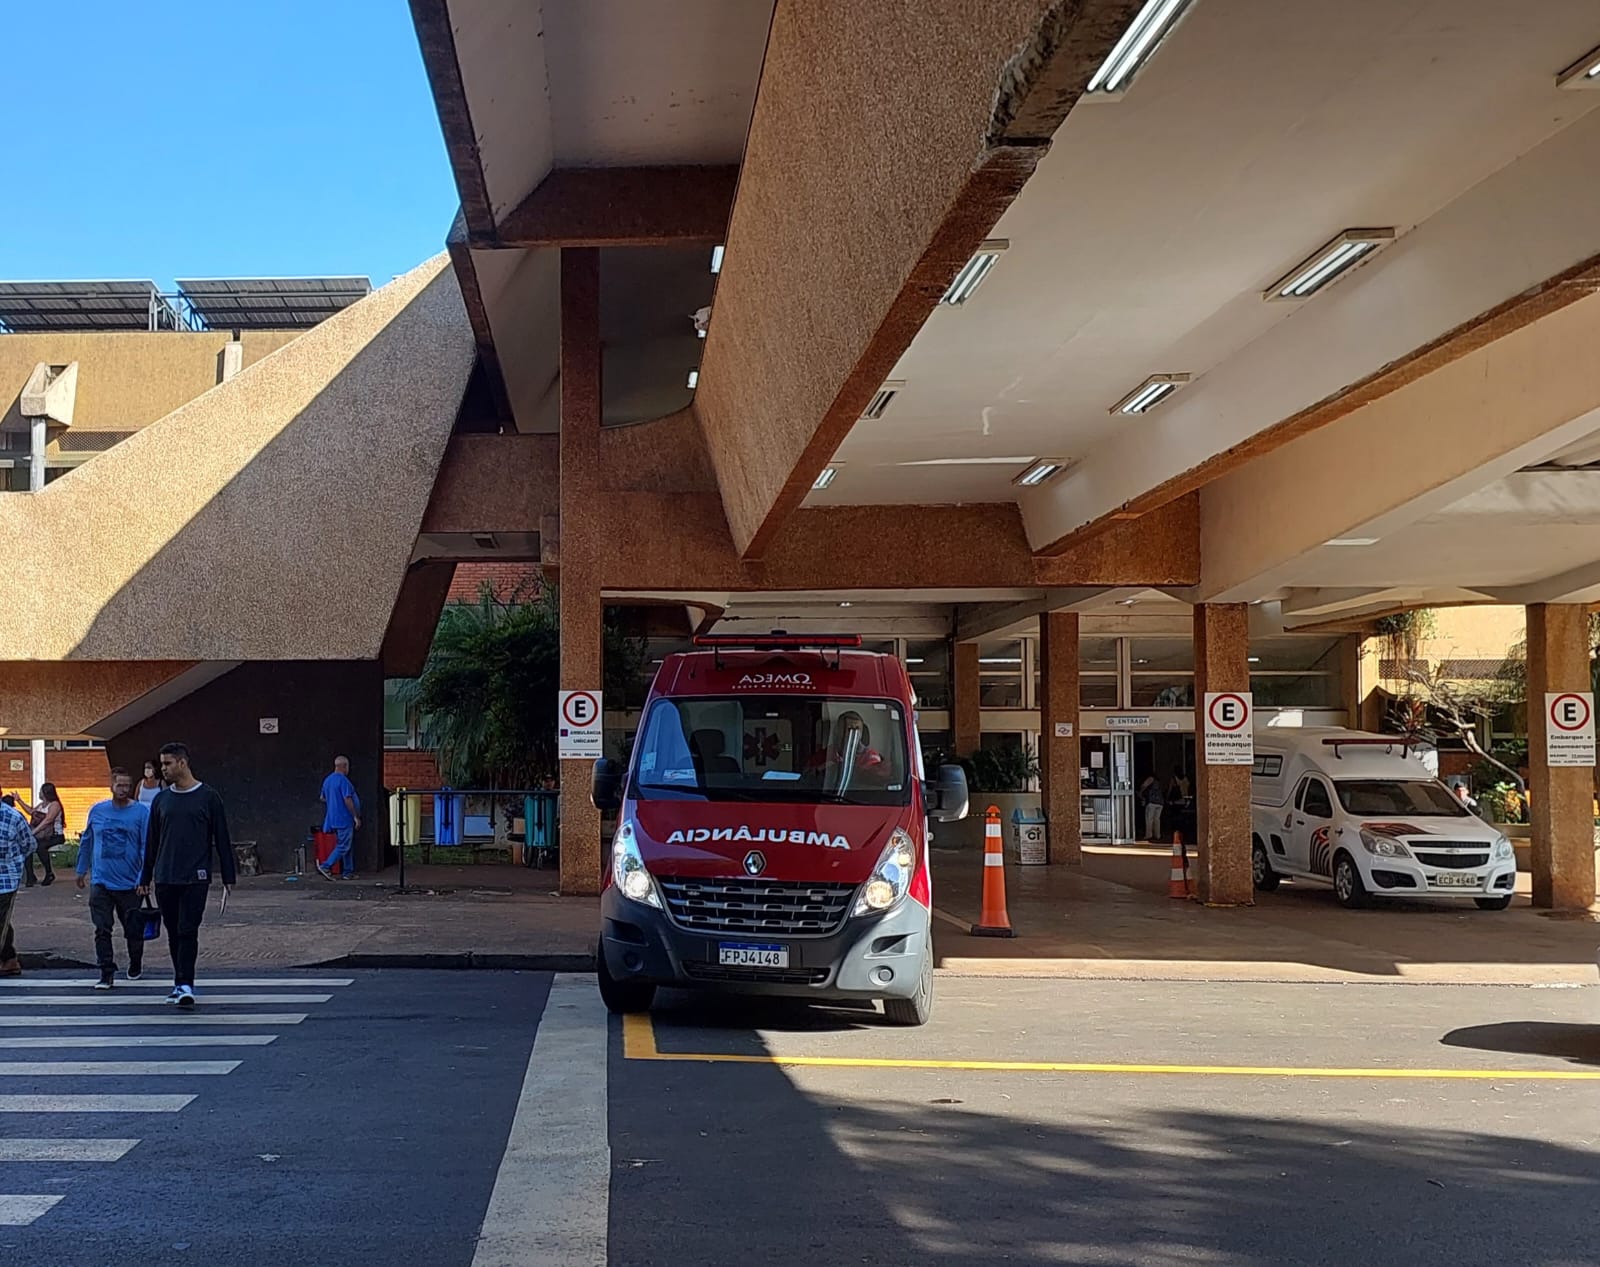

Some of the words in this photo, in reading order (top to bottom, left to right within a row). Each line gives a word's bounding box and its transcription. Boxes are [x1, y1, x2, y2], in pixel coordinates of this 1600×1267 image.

[575, 700, 586, 718] E
[1222, 703, 1235, 721] E
[1564, 703, 1577, 721] E
